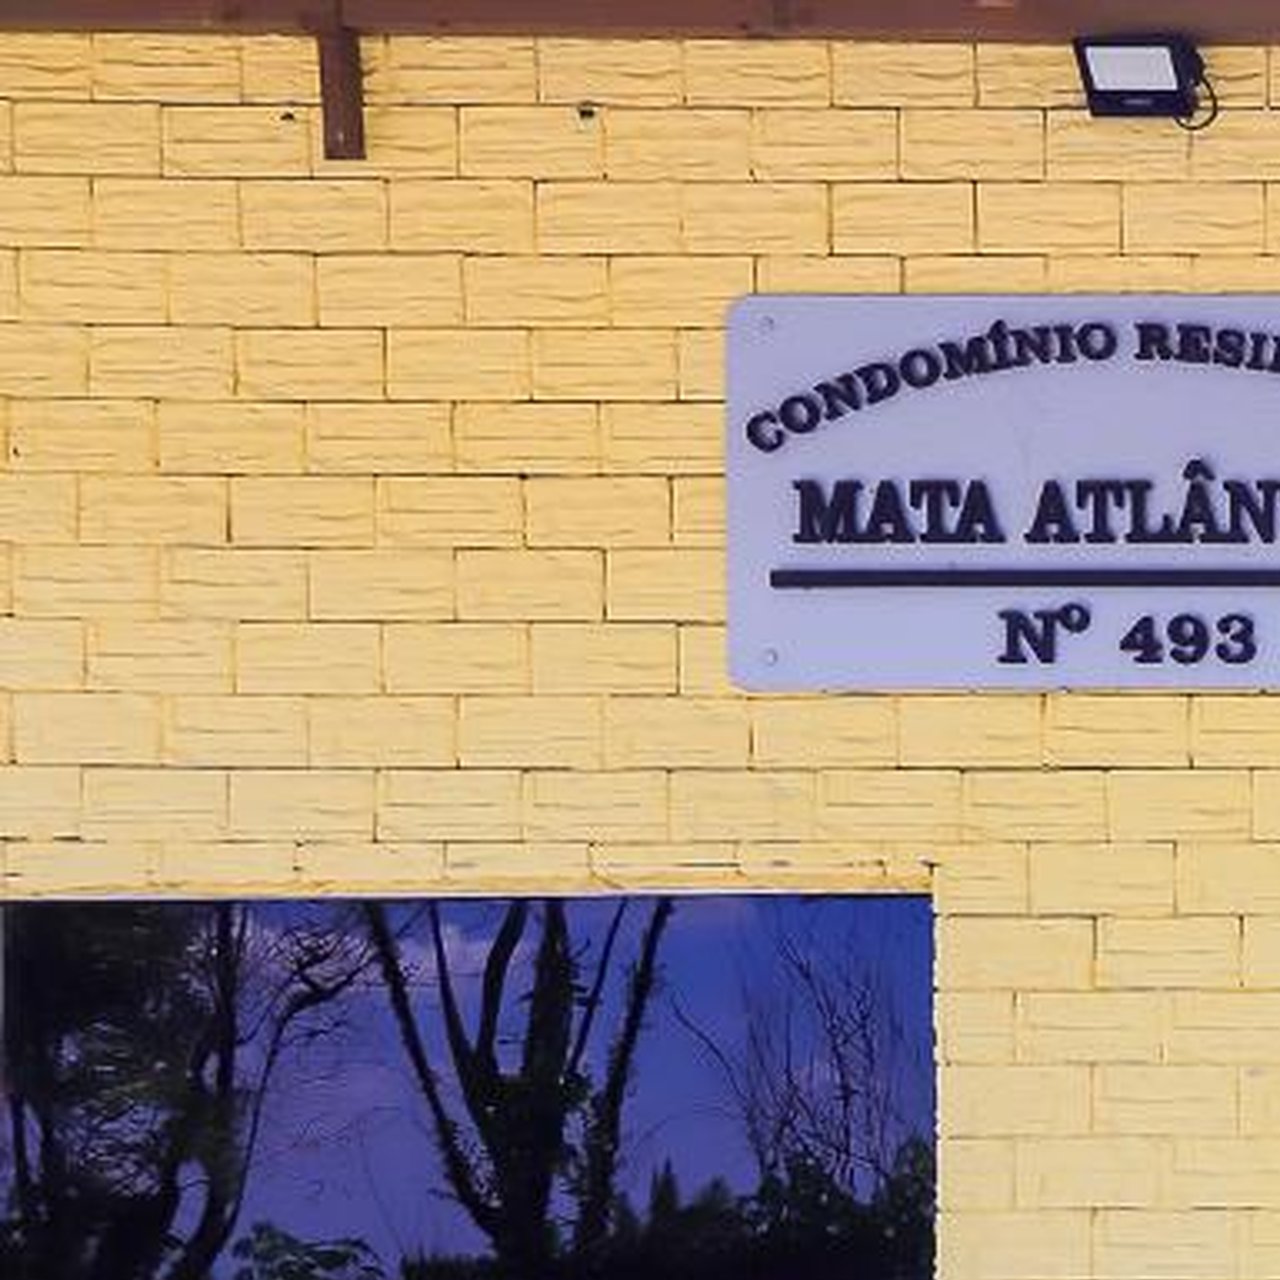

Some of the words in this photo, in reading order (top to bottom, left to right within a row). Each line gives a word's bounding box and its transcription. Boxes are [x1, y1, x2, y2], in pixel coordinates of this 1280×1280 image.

[744, 319, 1119, 454] CONDOMÍNIO
[792, 480, 1005, 546] MATA
[1119, 615, 1258, 665] 493
